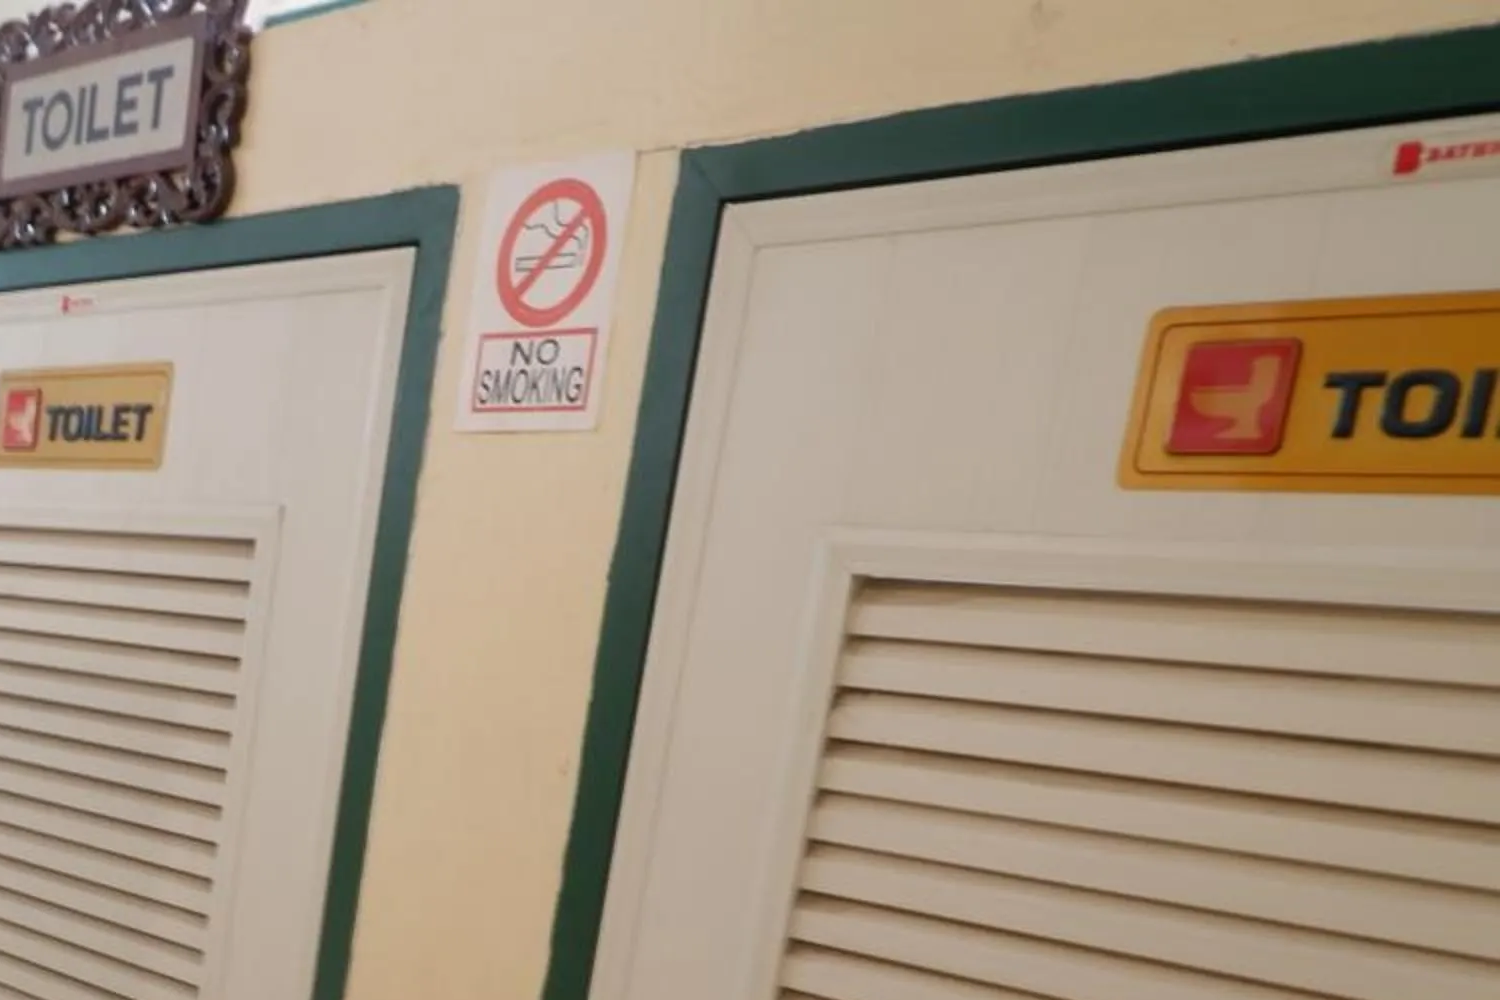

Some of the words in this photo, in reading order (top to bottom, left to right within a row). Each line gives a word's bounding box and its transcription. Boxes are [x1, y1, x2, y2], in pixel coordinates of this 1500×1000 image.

[22, 64, 175, 156] TOILET
[509, 338, 560, 366] NO
[478, 366, 584, 404] SMOKING
[1323, 367, 1500, 439] TOI
[46, 403, 153, 441] TOILET
